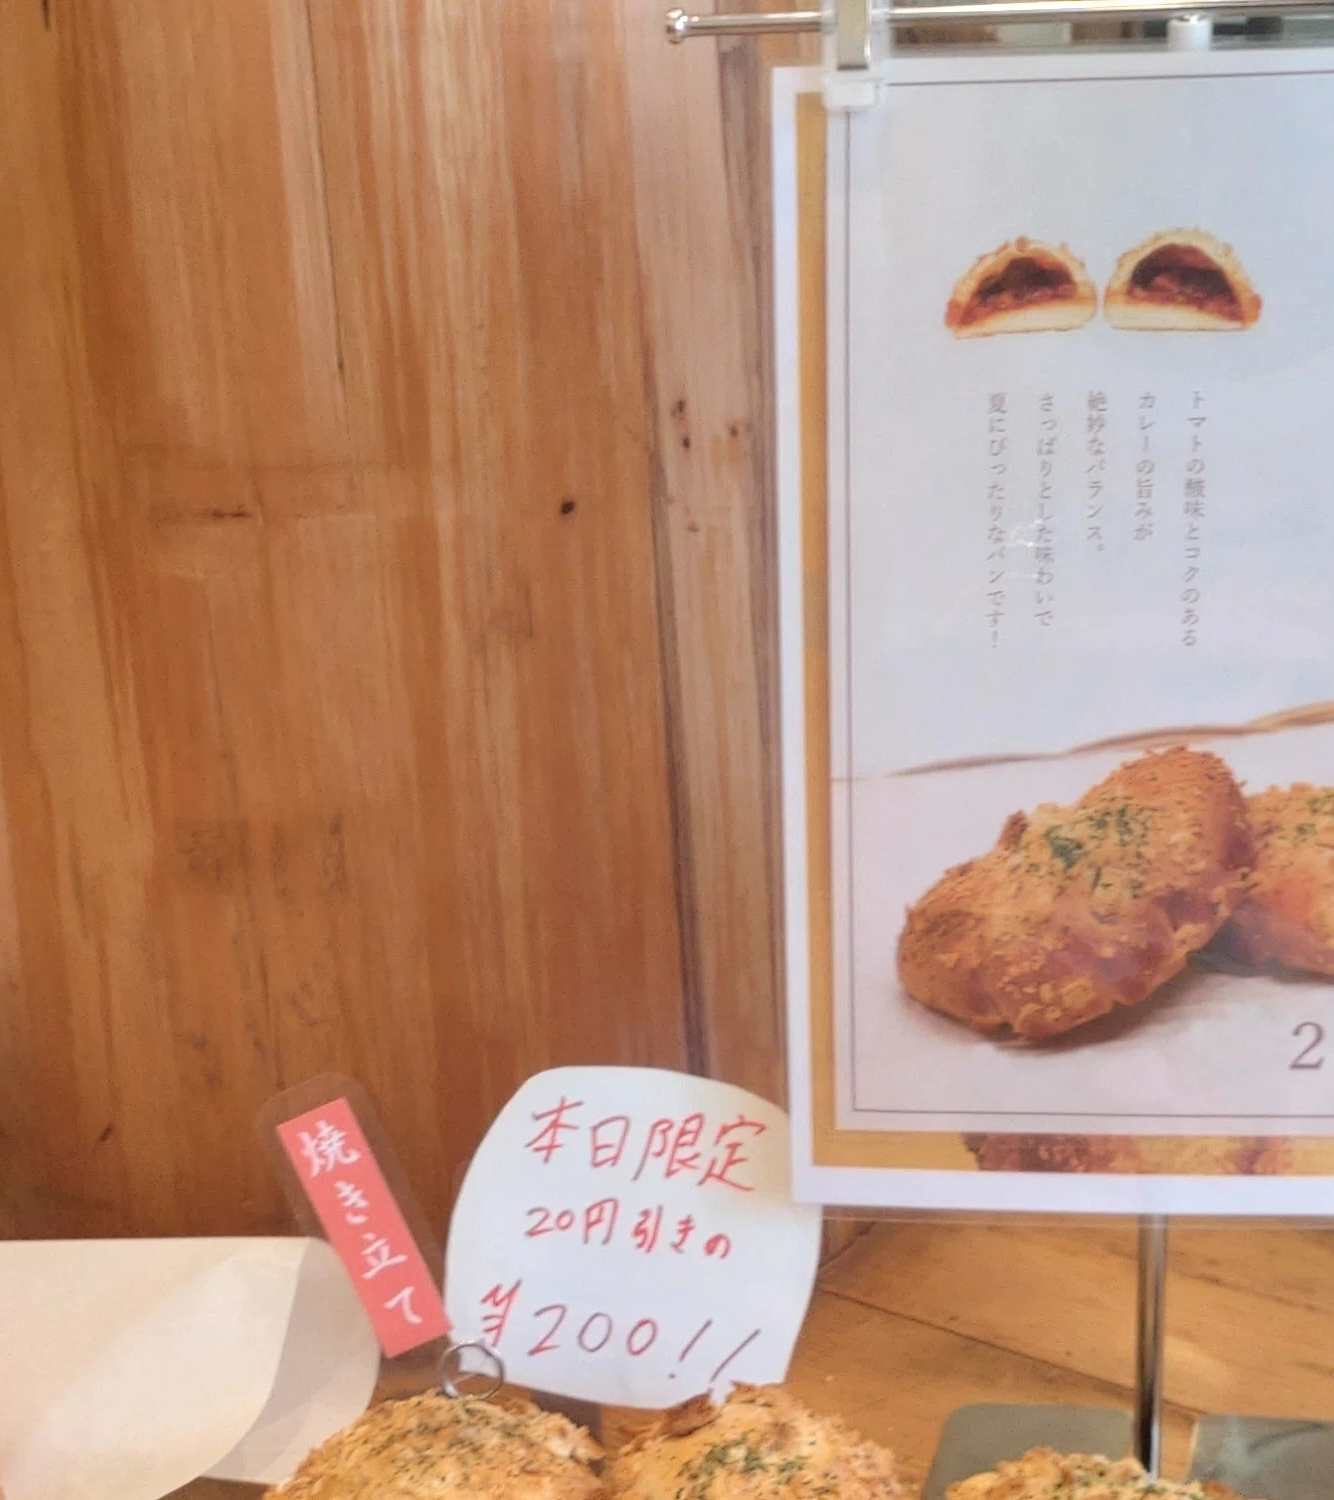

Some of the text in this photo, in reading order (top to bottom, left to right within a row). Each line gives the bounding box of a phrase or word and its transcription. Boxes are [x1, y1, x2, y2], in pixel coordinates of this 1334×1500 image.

[1133, 391, 1156, 541] カレーの旨みが
[1180, 390, 1207, 647] トマトの酸味とコクのある
[525, 1096, 767, 1193] 本日限定
[297, 1120, 424, 1327] 焼き立て
[524, 1198, 731, 1261] 20円引きの
